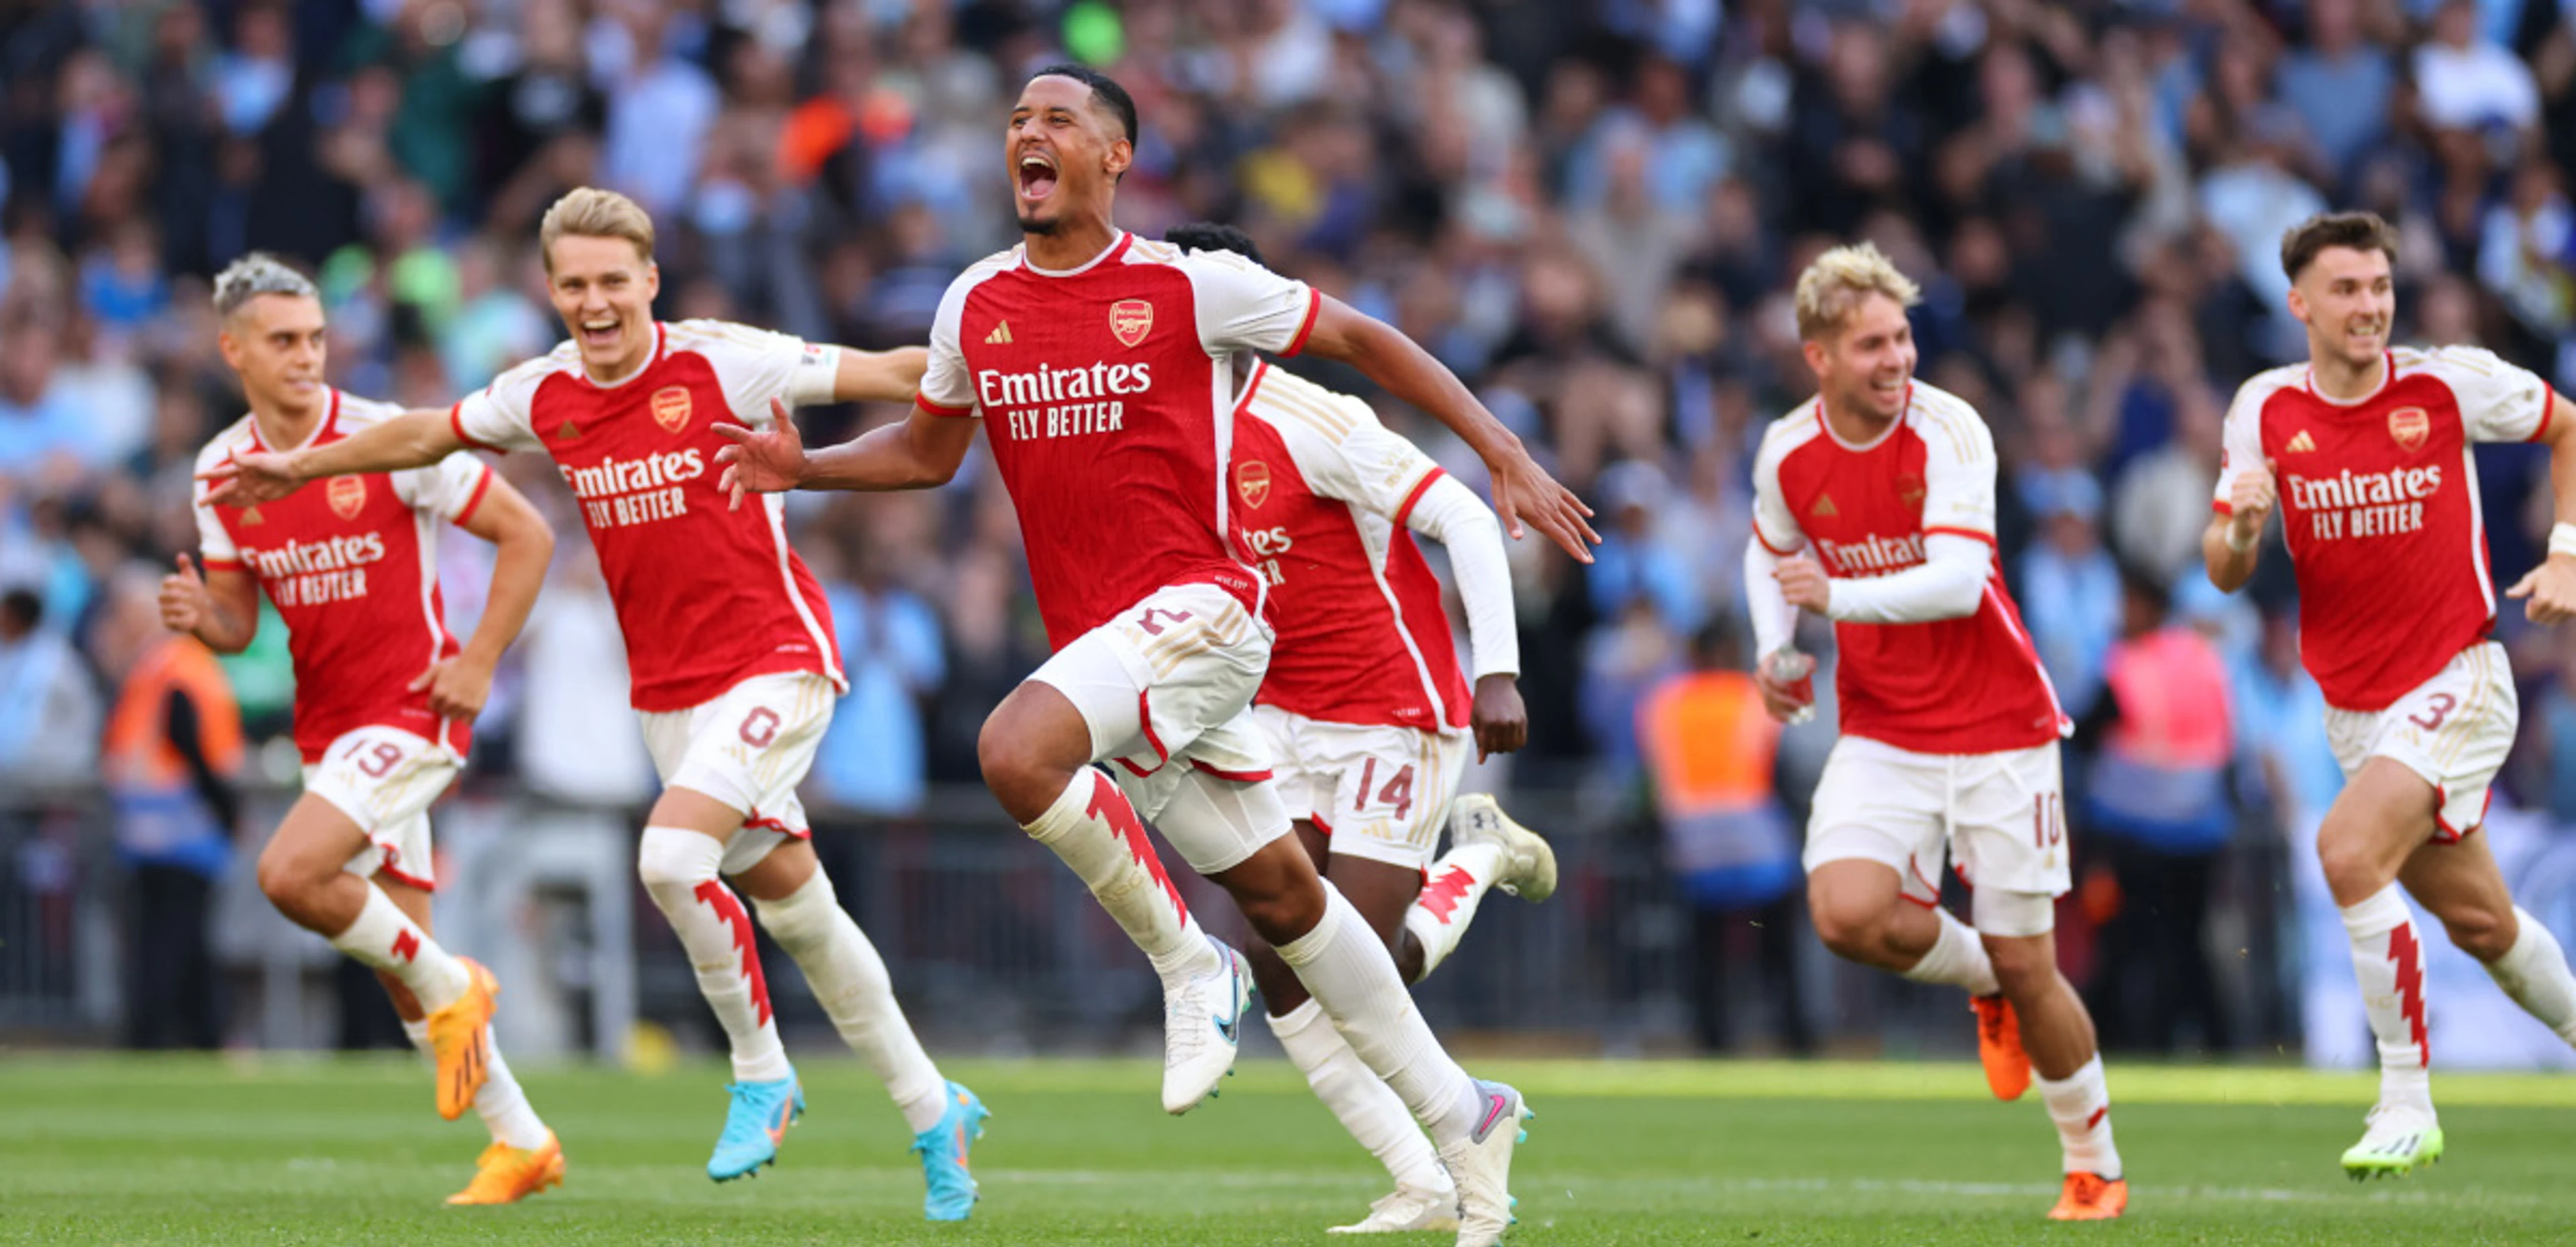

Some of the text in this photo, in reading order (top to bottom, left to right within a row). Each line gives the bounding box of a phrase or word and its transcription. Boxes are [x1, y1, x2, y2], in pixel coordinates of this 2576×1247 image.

[978, 360, 1151, 407] Emirates
[1008, 400, 1124, 441] FLY BETTER
[614, 486, 688, 527] BETTER
[2287, 464, 2442, 510] Emirates
[2313, 501, 2424, 540] FLY BETTER
[1818, 533, 1926, 571] Emirat
[2408, 693, 2457, 731] 3
[342, 739, 402, 778] 19
[1354, 757, 1413, 820] 14
[2035, 792, 2061, 849] 10
